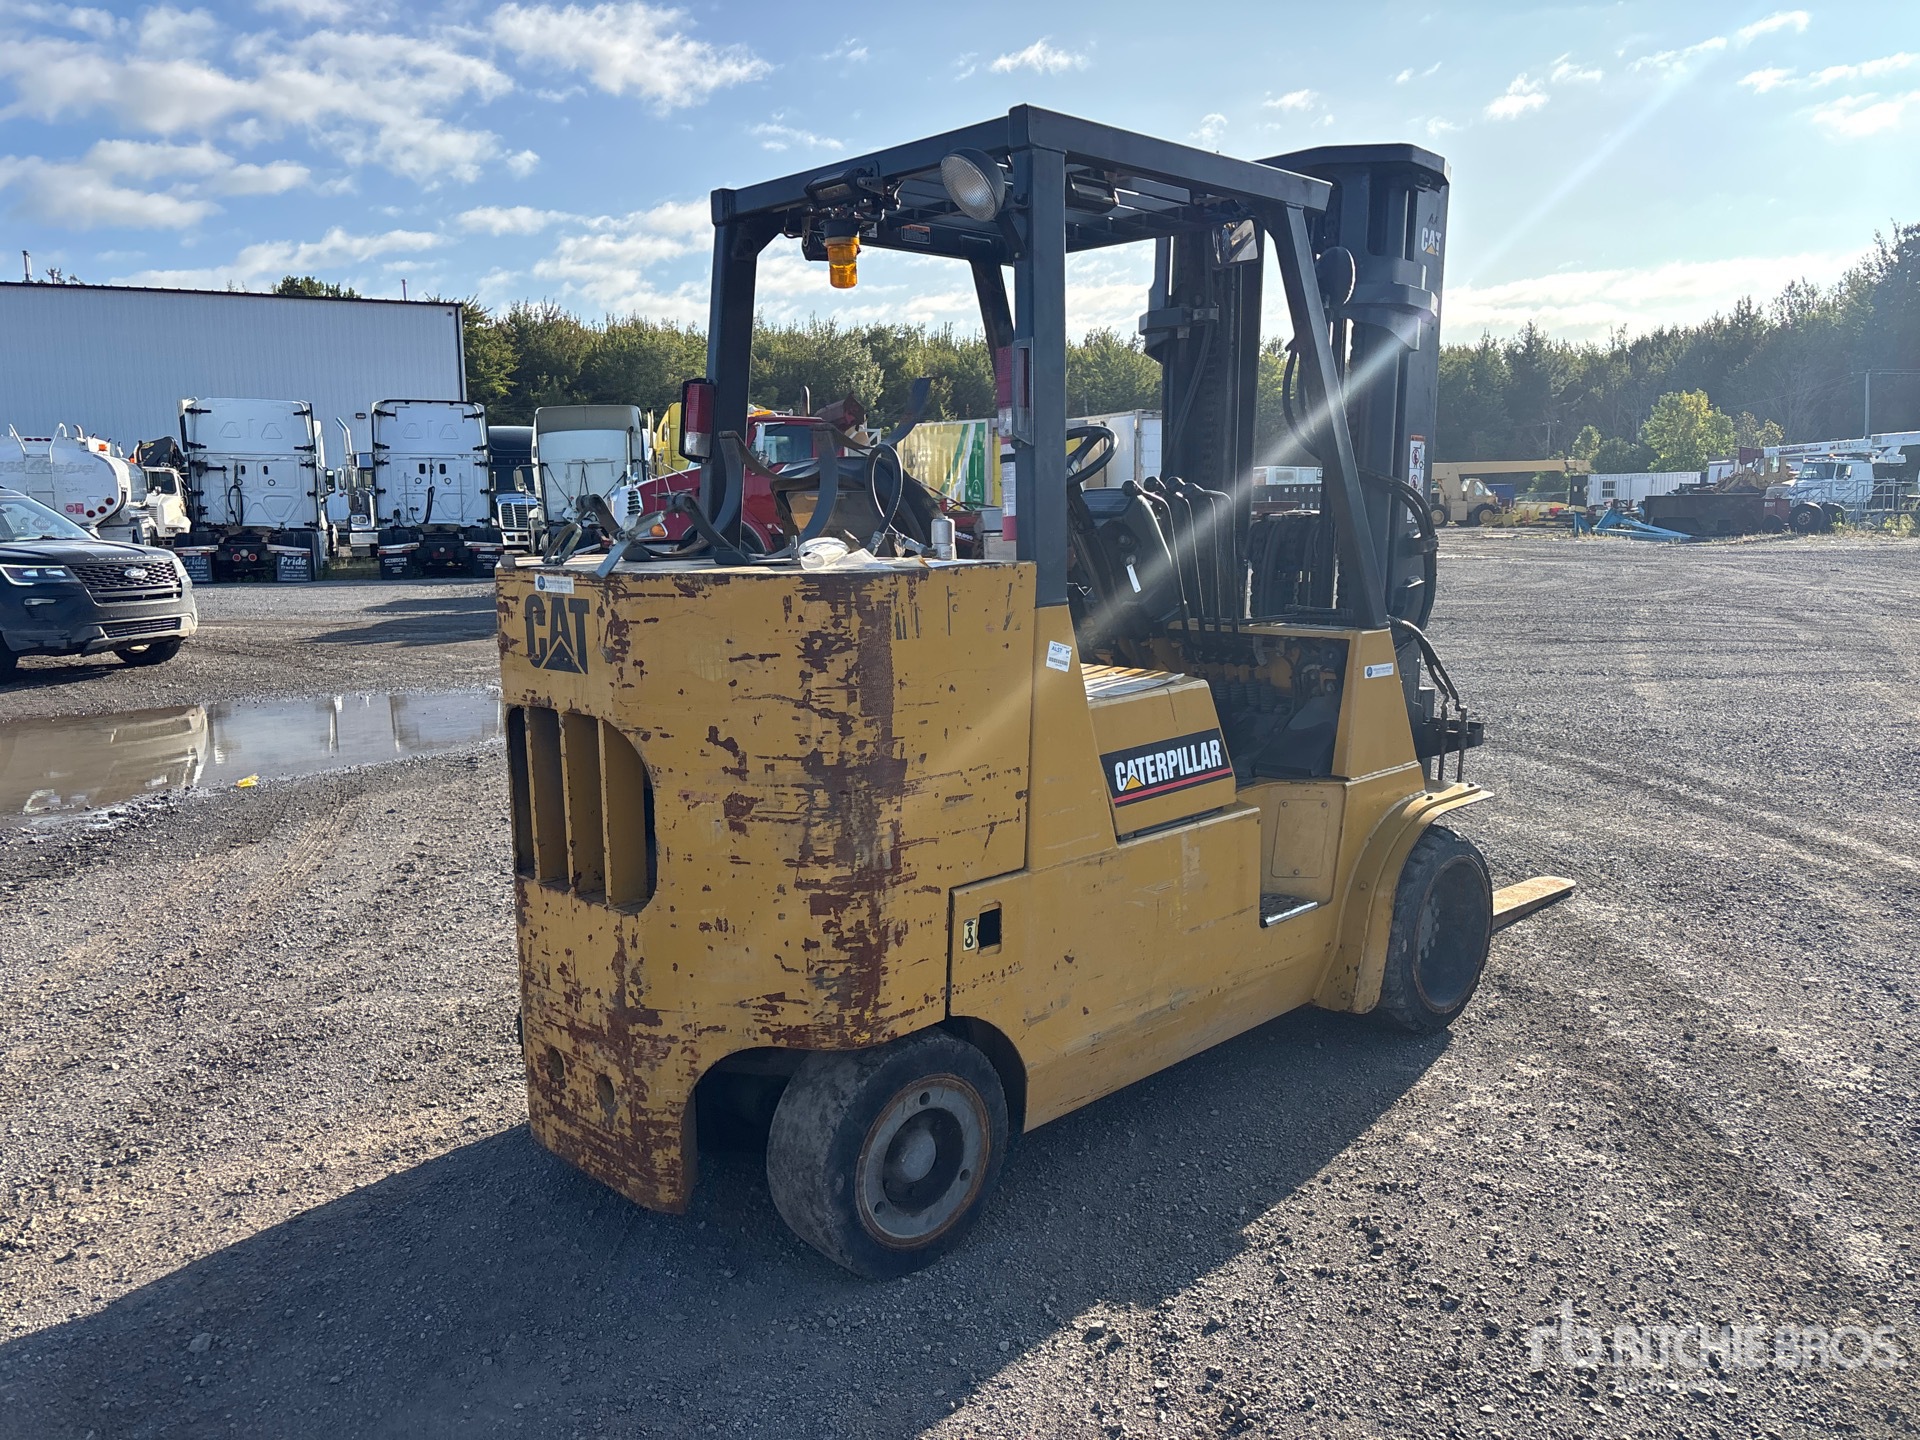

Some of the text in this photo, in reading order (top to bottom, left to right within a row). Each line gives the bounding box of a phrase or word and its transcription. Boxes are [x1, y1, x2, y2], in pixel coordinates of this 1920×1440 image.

[1420, 227, 1442, 257] CAT
[280, 556, 307, 566] Pride
[524, 594, 591, 675] CAT
[1114, 738, 1223, 792] CATERPILLAR
